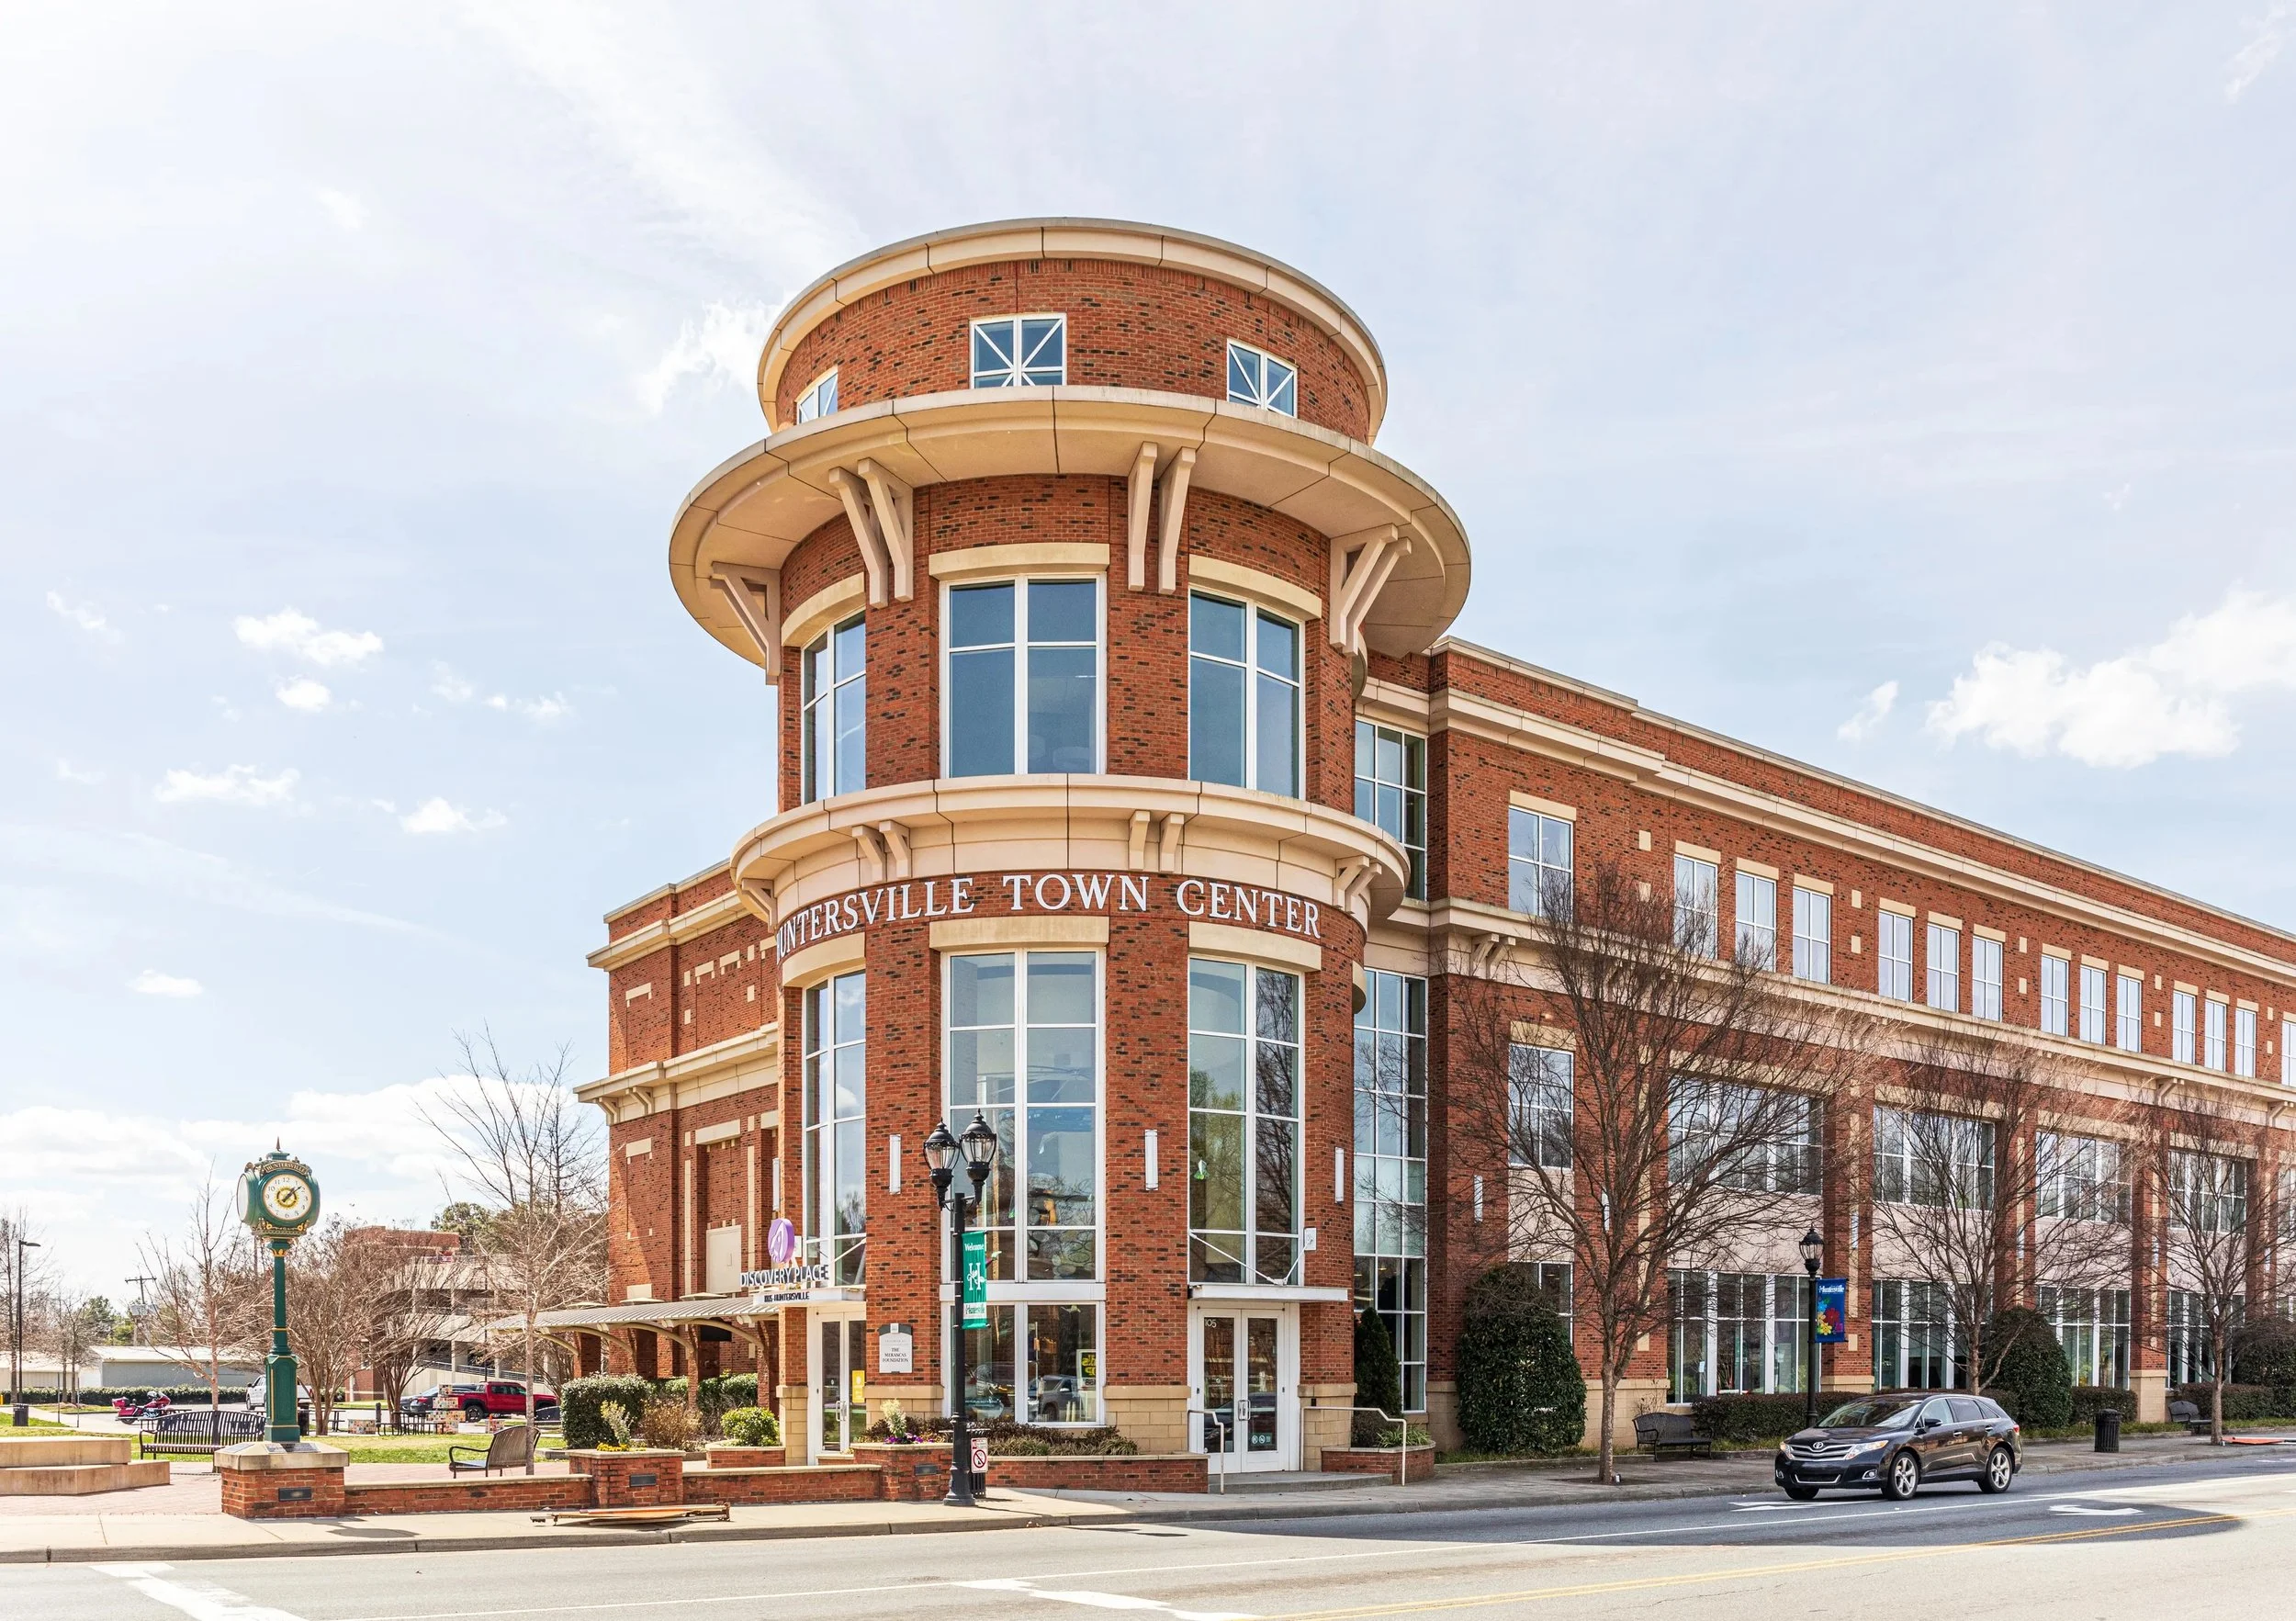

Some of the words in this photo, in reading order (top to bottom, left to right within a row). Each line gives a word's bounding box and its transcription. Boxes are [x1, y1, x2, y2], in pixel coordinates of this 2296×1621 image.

[1002, 873, 1150, 912] TOWN
[1176, 879, 1322, 939] CENTER
[266, 1163, 304, 1173] HUNTERSVILLE
[739, 1267, 792, 1287] DISCOVERY
[793, 1264, 828, 1283] PLACE
[1205, 1319, 1217, 1328] 105
